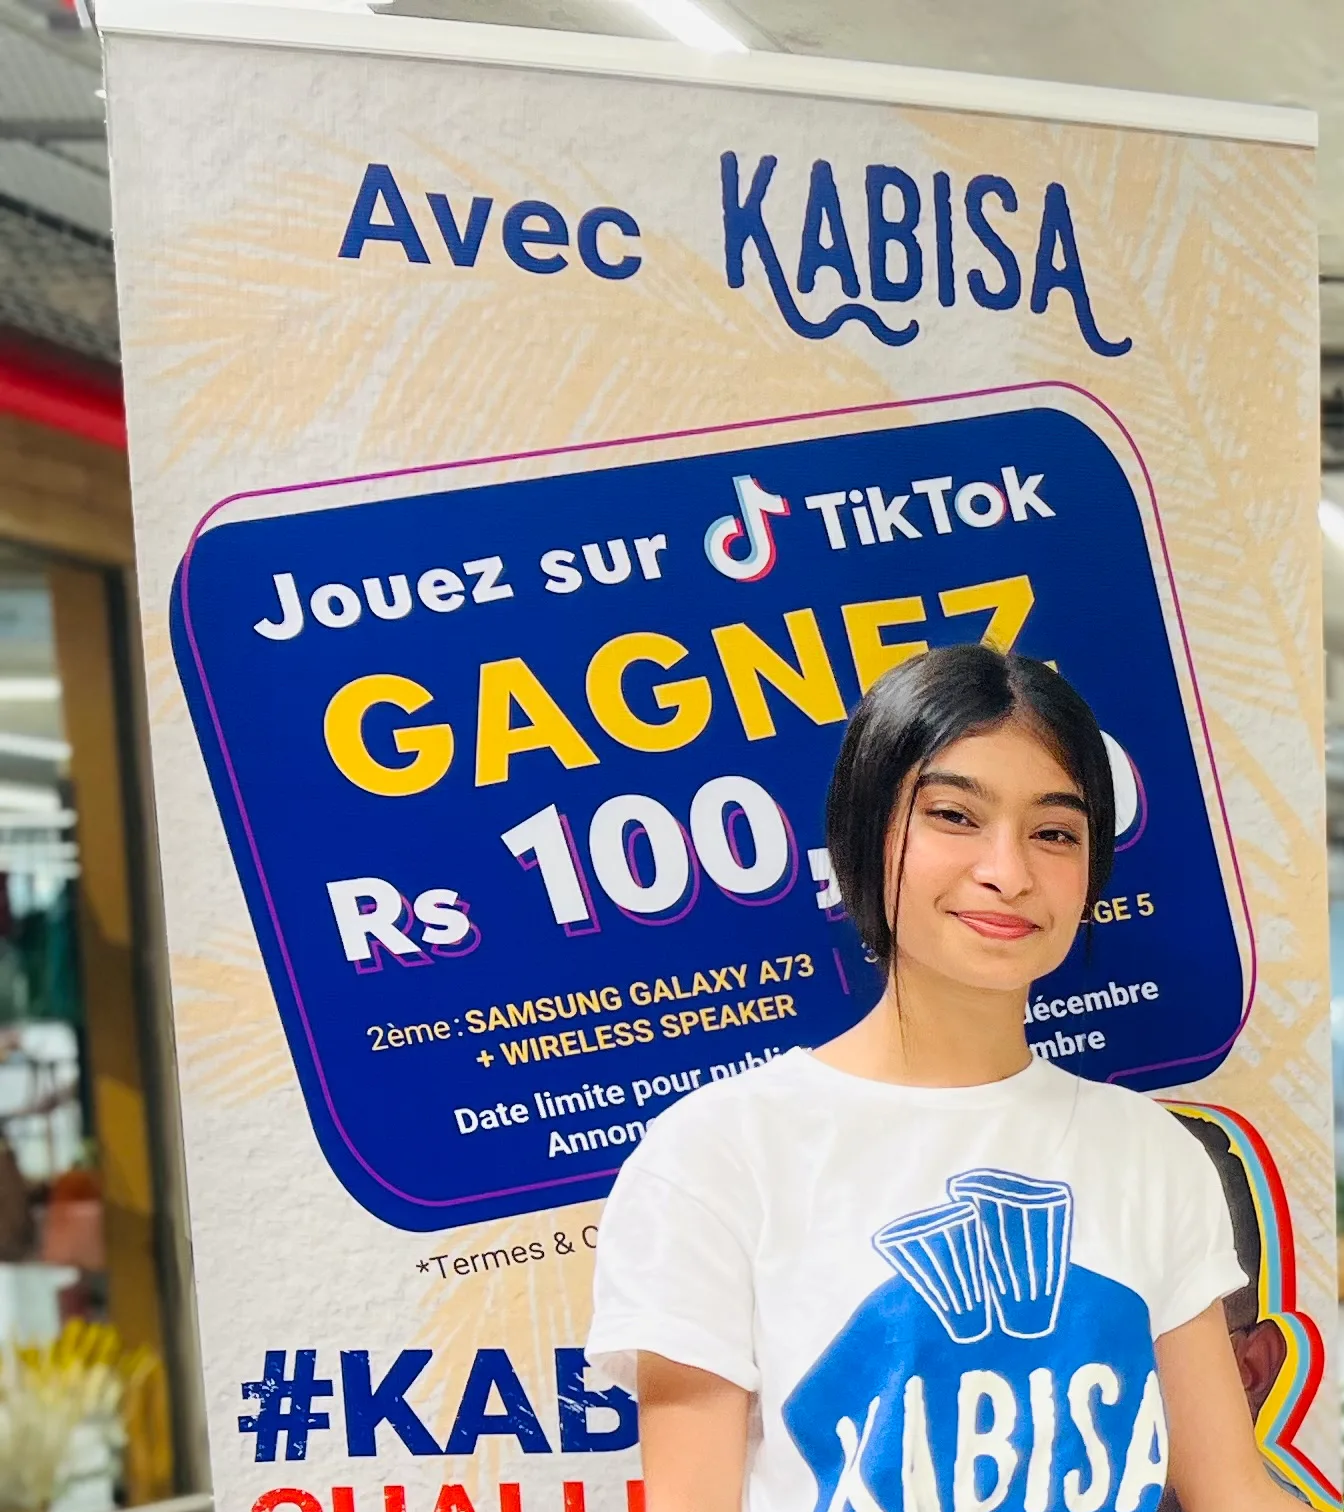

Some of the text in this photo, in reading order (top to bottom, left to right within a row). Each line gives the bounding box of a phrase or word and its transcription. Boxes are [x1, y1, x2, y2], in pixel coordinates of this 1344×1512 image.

[338, 150, 1132, 358] Avec KABISA
[253, 465, 1056, 642] Jouez sur TikTok
[326, 877, 471, 962] Rs
[1136, 892, 1155, 917] 5
[464, 985, 623, 1035] SAMSUNG
[630, 963, 749, 1007] GALAXY
[758, 952, 815, 985] A73
[476, 993, 798, 1068] + WIRELESS SPEAKER
[1029, 1030, 1106, 1060] mbre
[454, 1100, 530, 1135] Date
[534, 1083, 625, 1120] limite
[632, 1064, 702, 1108] pour
[547, 1118, 653, 1158] Annon
[554, 1232, 575, 1256] &
[582, 1224, 599, 1250] C
[238, 1348, 640, 1463] #KAB
